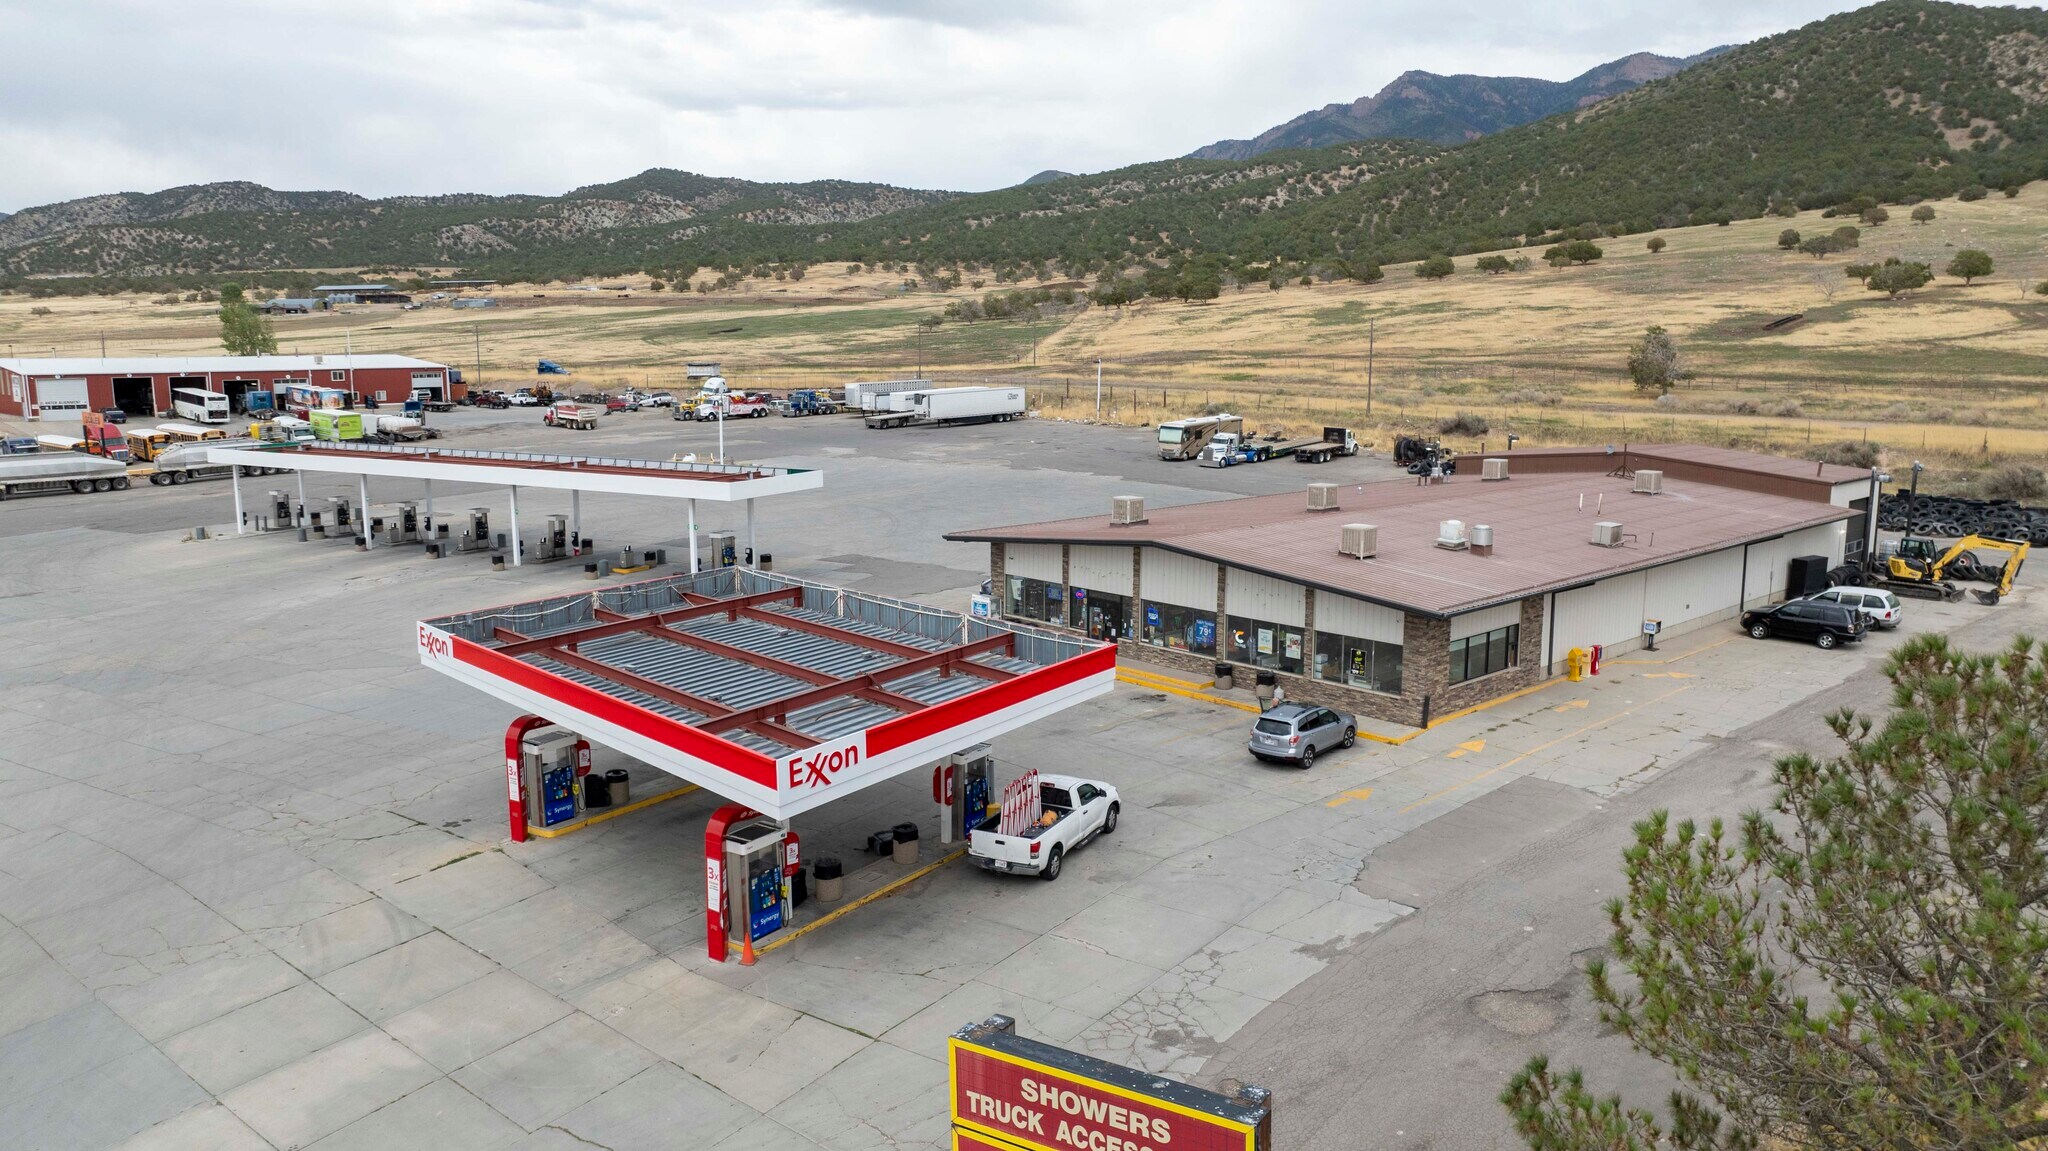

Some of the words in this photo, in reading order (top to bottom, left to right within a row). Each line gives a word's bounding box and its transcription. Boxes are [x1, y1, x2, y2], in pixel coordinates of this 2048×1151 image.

[419, 625, 449, 659] Exxon
[789, 744, 859, 788] Exxon
[554, 803, 573, 814] Synergy
[708, 867, 719, 881] 3x
[760, 911, 780, 926] Synergy
[966, 1090, 1045, 1136] TRUCK
[1020, 1078, 1171, 1144] SHOWERS
